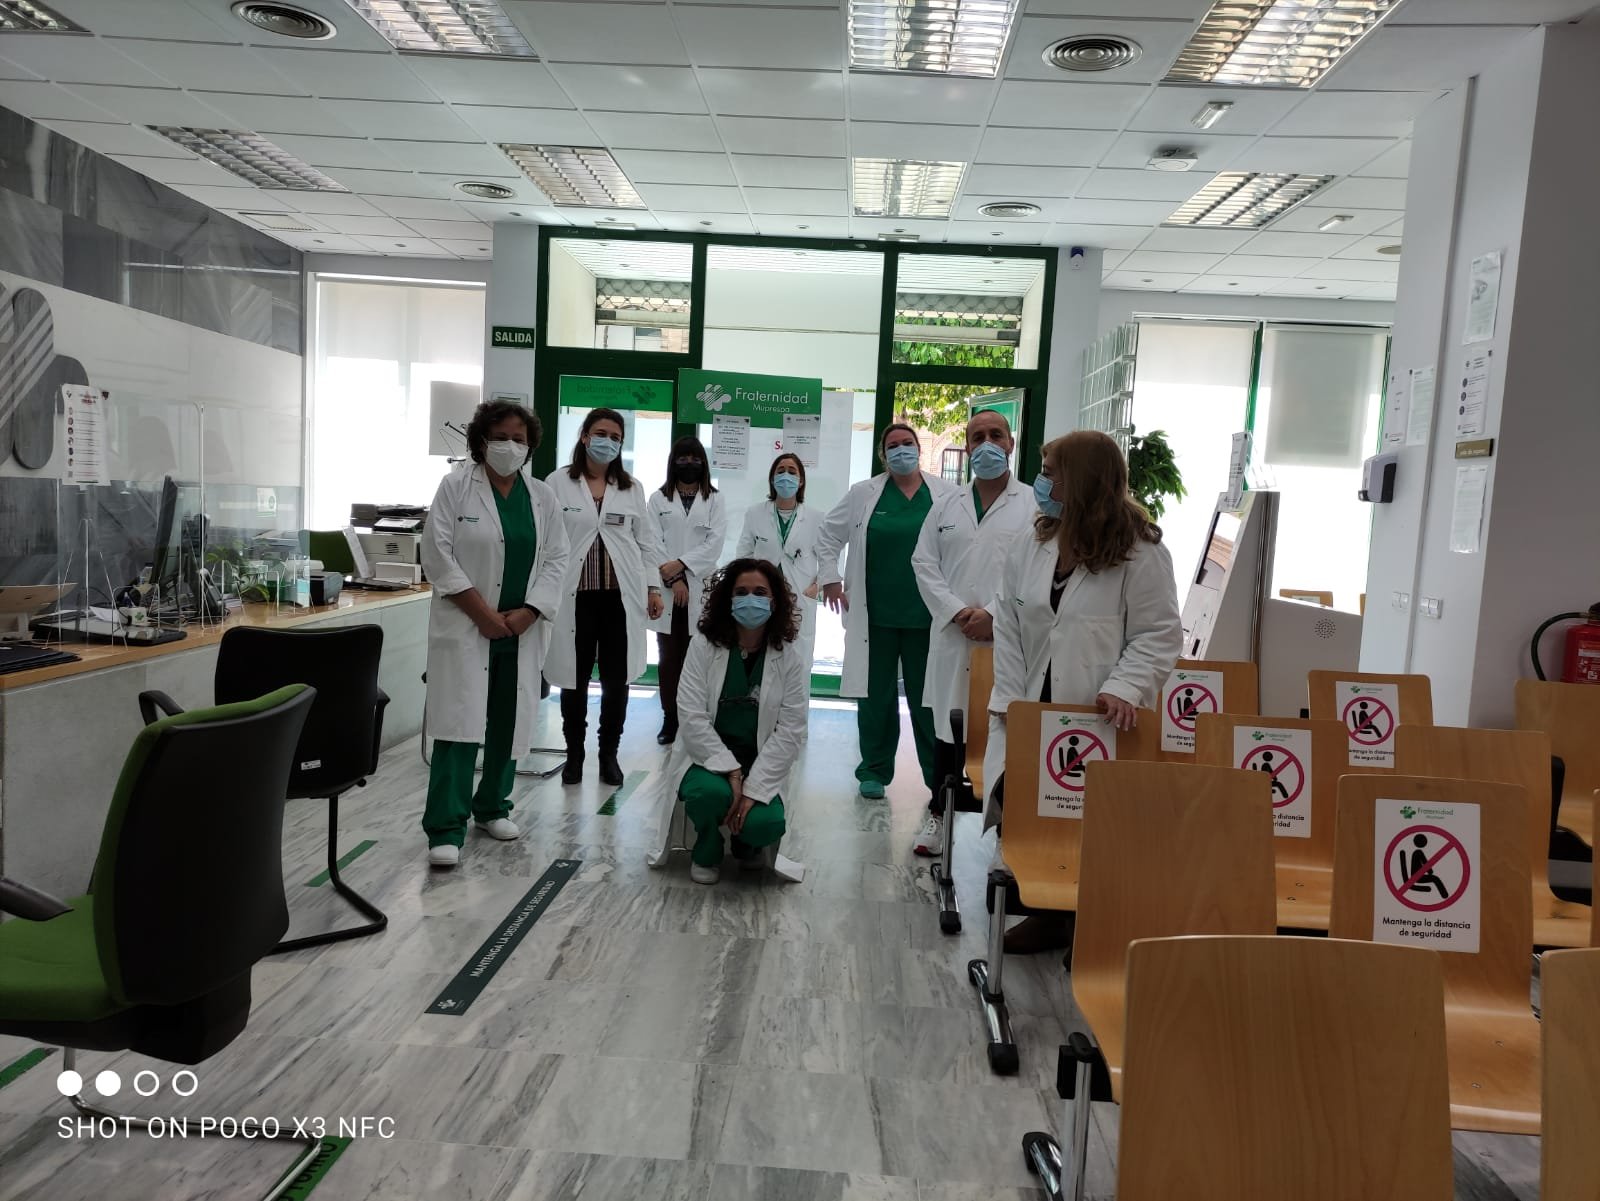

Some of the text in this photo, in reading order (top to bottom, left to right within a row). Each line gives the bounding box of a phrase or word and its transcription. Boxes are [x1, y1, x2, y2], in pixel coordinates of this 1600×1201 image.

[495, 331, 532, 344] SALIDA
[735, 387, 808, 404] Fraternidad
[752, 403, 790, 413] Muprespa
[774, 440, 783, 450] S
[1045, 794, 1074, 803] Mantenga
[1278, 813, 1305, 821] distancia
[1382, 916, 1471, 930] Mantenga la distancia
[1399, 928, 1452, 939] de seguridad
[469, 944, 505, 978] MANTENGA
[502, 911, 531, 937] DISTANCIA
